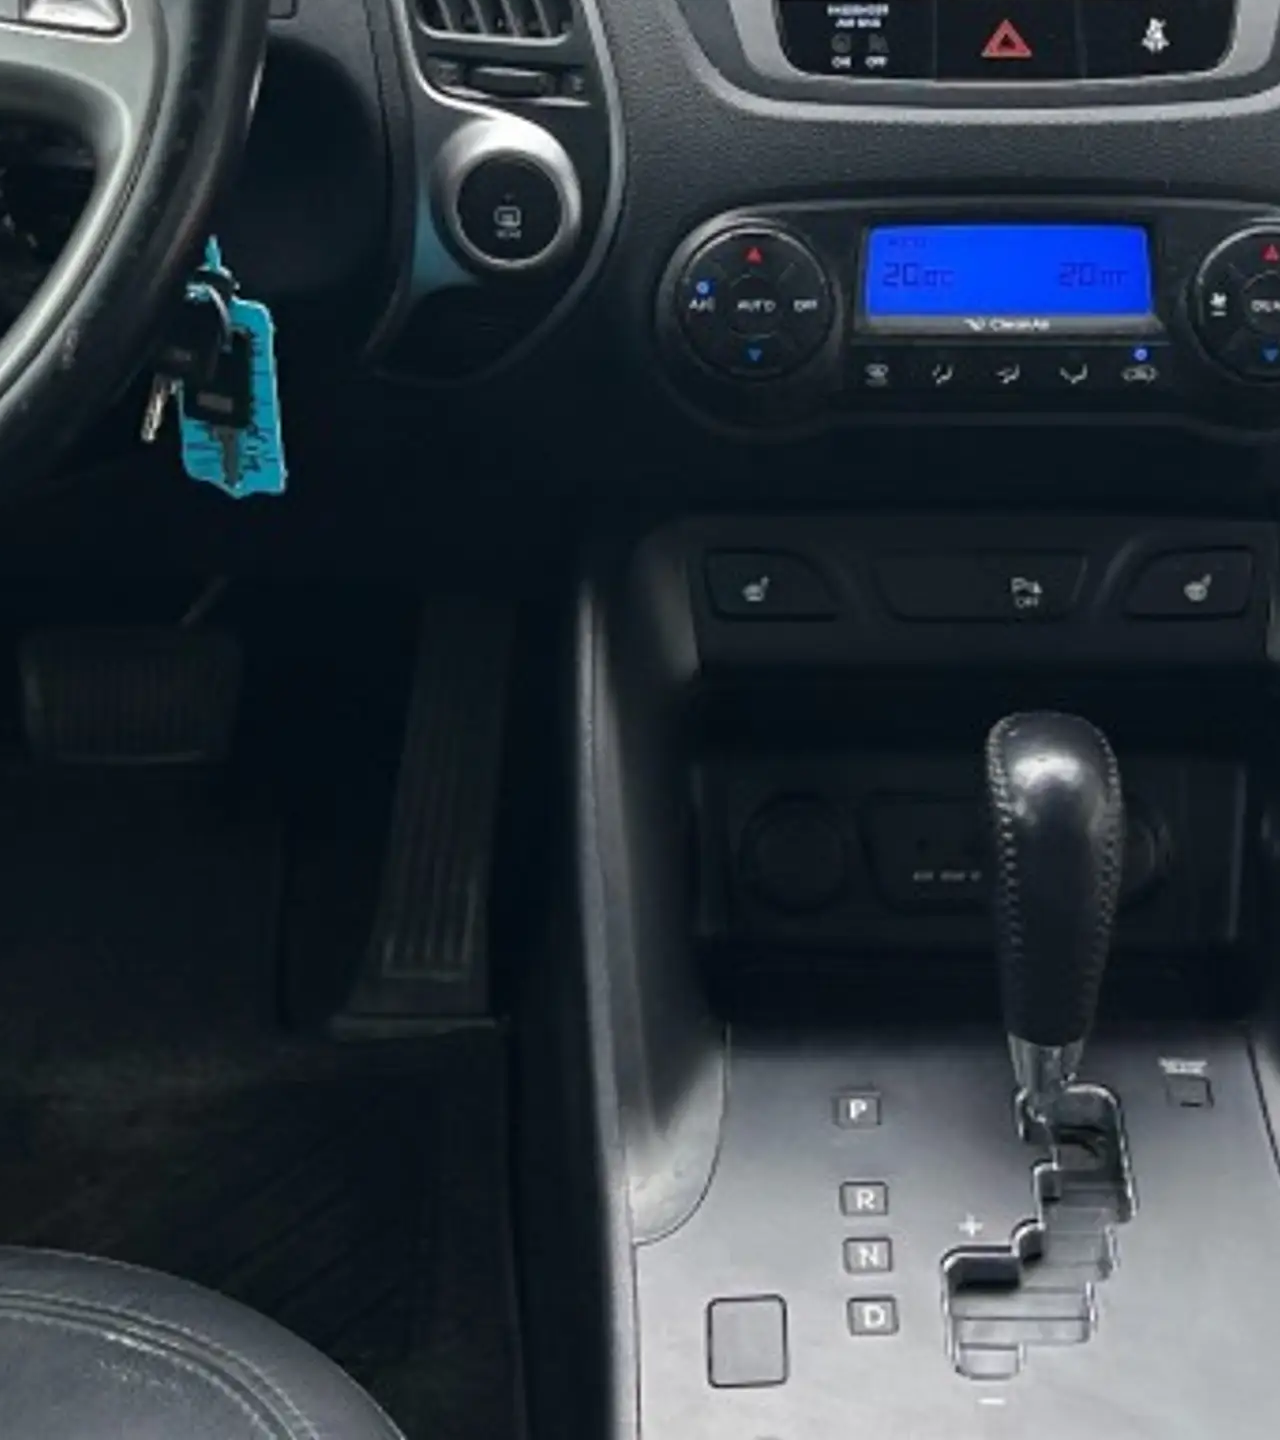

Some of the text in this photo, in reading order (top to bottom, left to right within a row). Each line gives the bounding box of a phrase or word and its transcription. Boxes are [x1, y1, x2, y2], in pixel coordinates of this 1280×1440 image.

[849, 1098, 868, 1120] P
[856, 1188, 876, 1211] R
[859, 1245, 879, 1268] N
[863, 1304, 887, 1329] D
